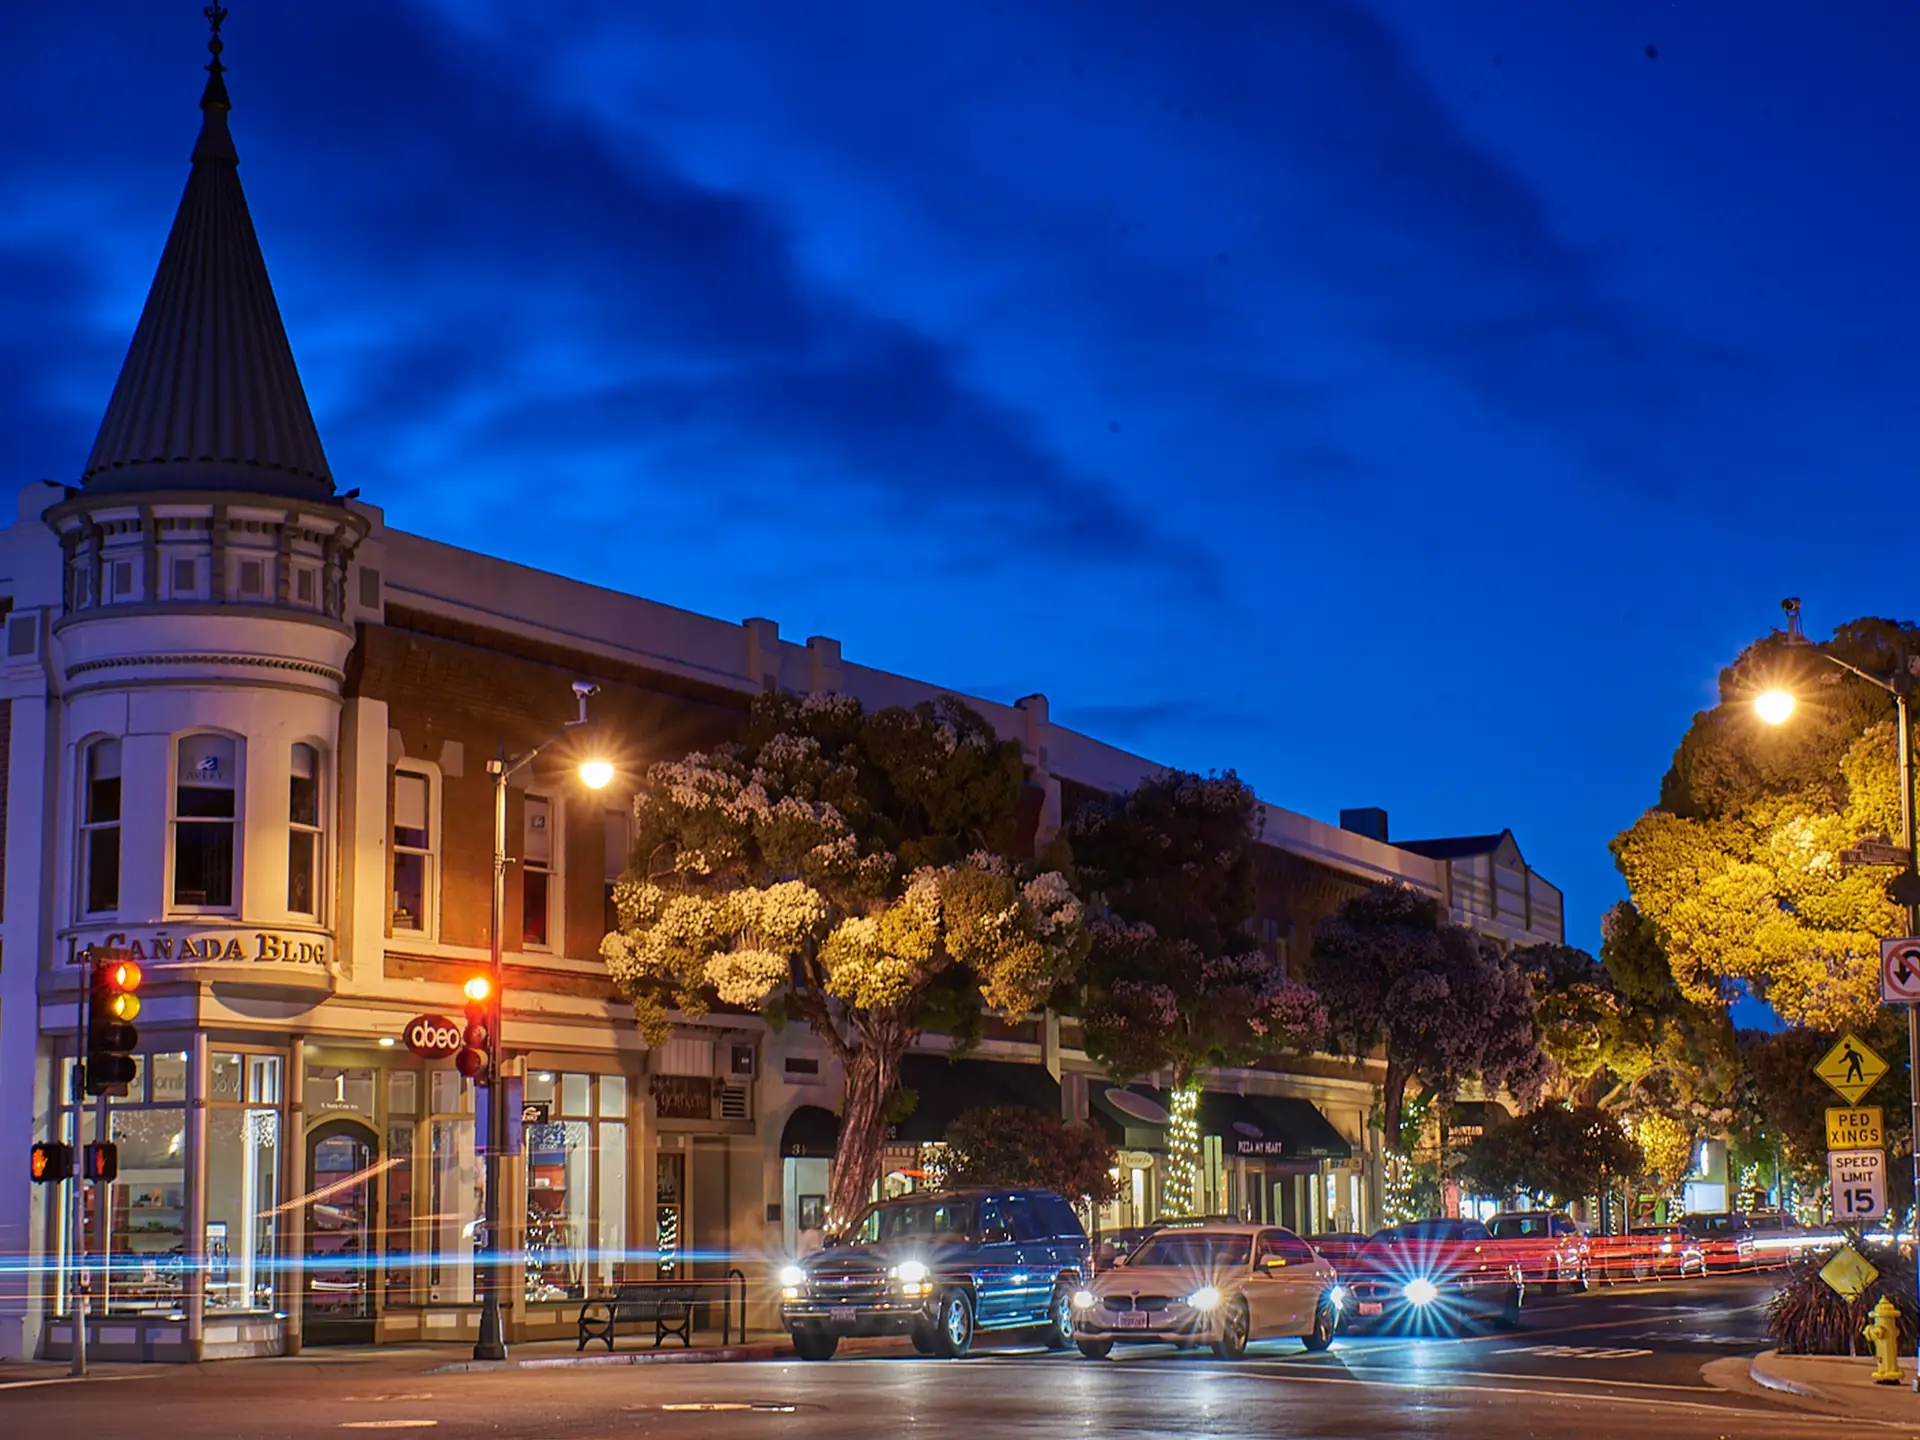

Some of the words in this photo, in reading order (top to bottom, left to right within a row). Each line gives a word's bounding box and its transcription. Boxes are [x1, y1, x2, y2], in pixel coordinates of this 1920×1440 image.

[411, 1020, 460, 1049] abeo
[335, 1073, 345, 1102] 1
[1839, 1113, 1870, 1127] PED
[1831, 1128, 1879, 1143] XINGS
[1237, 1141, 1254, 1153] PIZZA
[1254, 1142, 1264, 1154] MY
[1265, 1142, 1283, 1154] HEART
[1836, 1156, 1879, 1168] SPEED
[1841, 1172, 1873, 1183] LIMIT
[1843, 1188, 1875, 1214] 15
